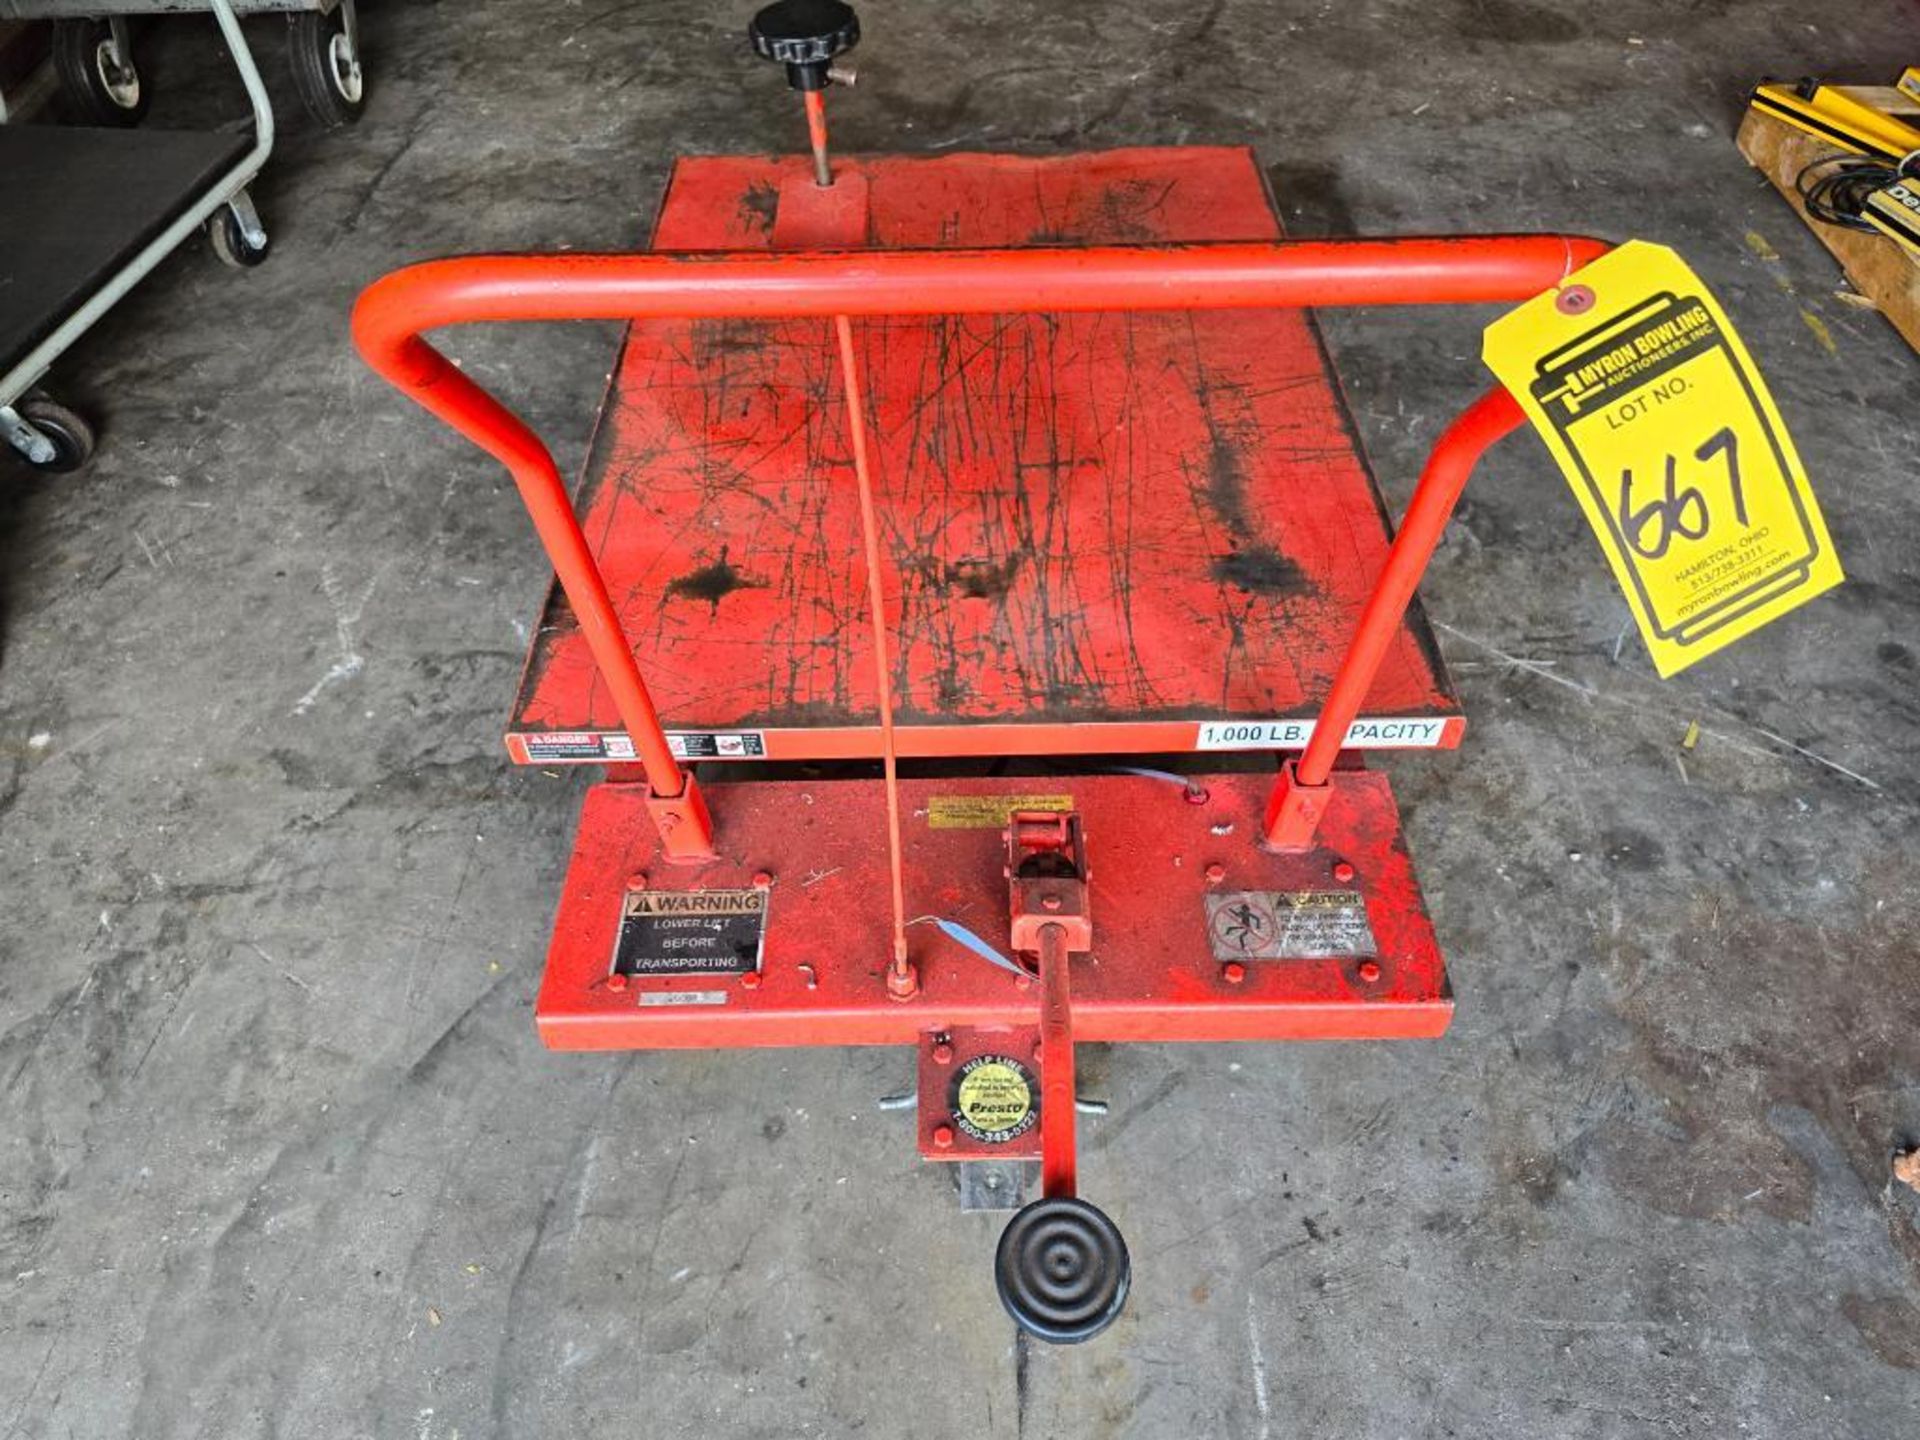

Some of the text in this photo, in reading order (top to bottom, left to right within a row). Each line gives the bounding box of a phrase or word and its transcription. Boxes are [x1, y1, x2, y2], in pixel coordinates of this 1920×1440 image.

[1578, 306, 1709, 386] MYRON BOWLING
[1606, 377, 1693, 430] LOT NO.
[1620, 426, 1750, 560] 667
[1739, 526, 1769, 548] OHIO
[1677, 550, 1791, 616] myronbowling.com
[1206, 723, 1437, 743] 1,000 LB. PACITY
[657, 894, 760, 911] WARNING
[1296, 894, 1358, 905] CAUTION
[653, 919, 700, 930] LOWER
[662, 937, 716, 949] BEFORE
[635, 956, 738, 969] TRANSPORTING
[962, 1055, 993, 1074] HELP
[969, 1102, 1024, 1113] Presto
